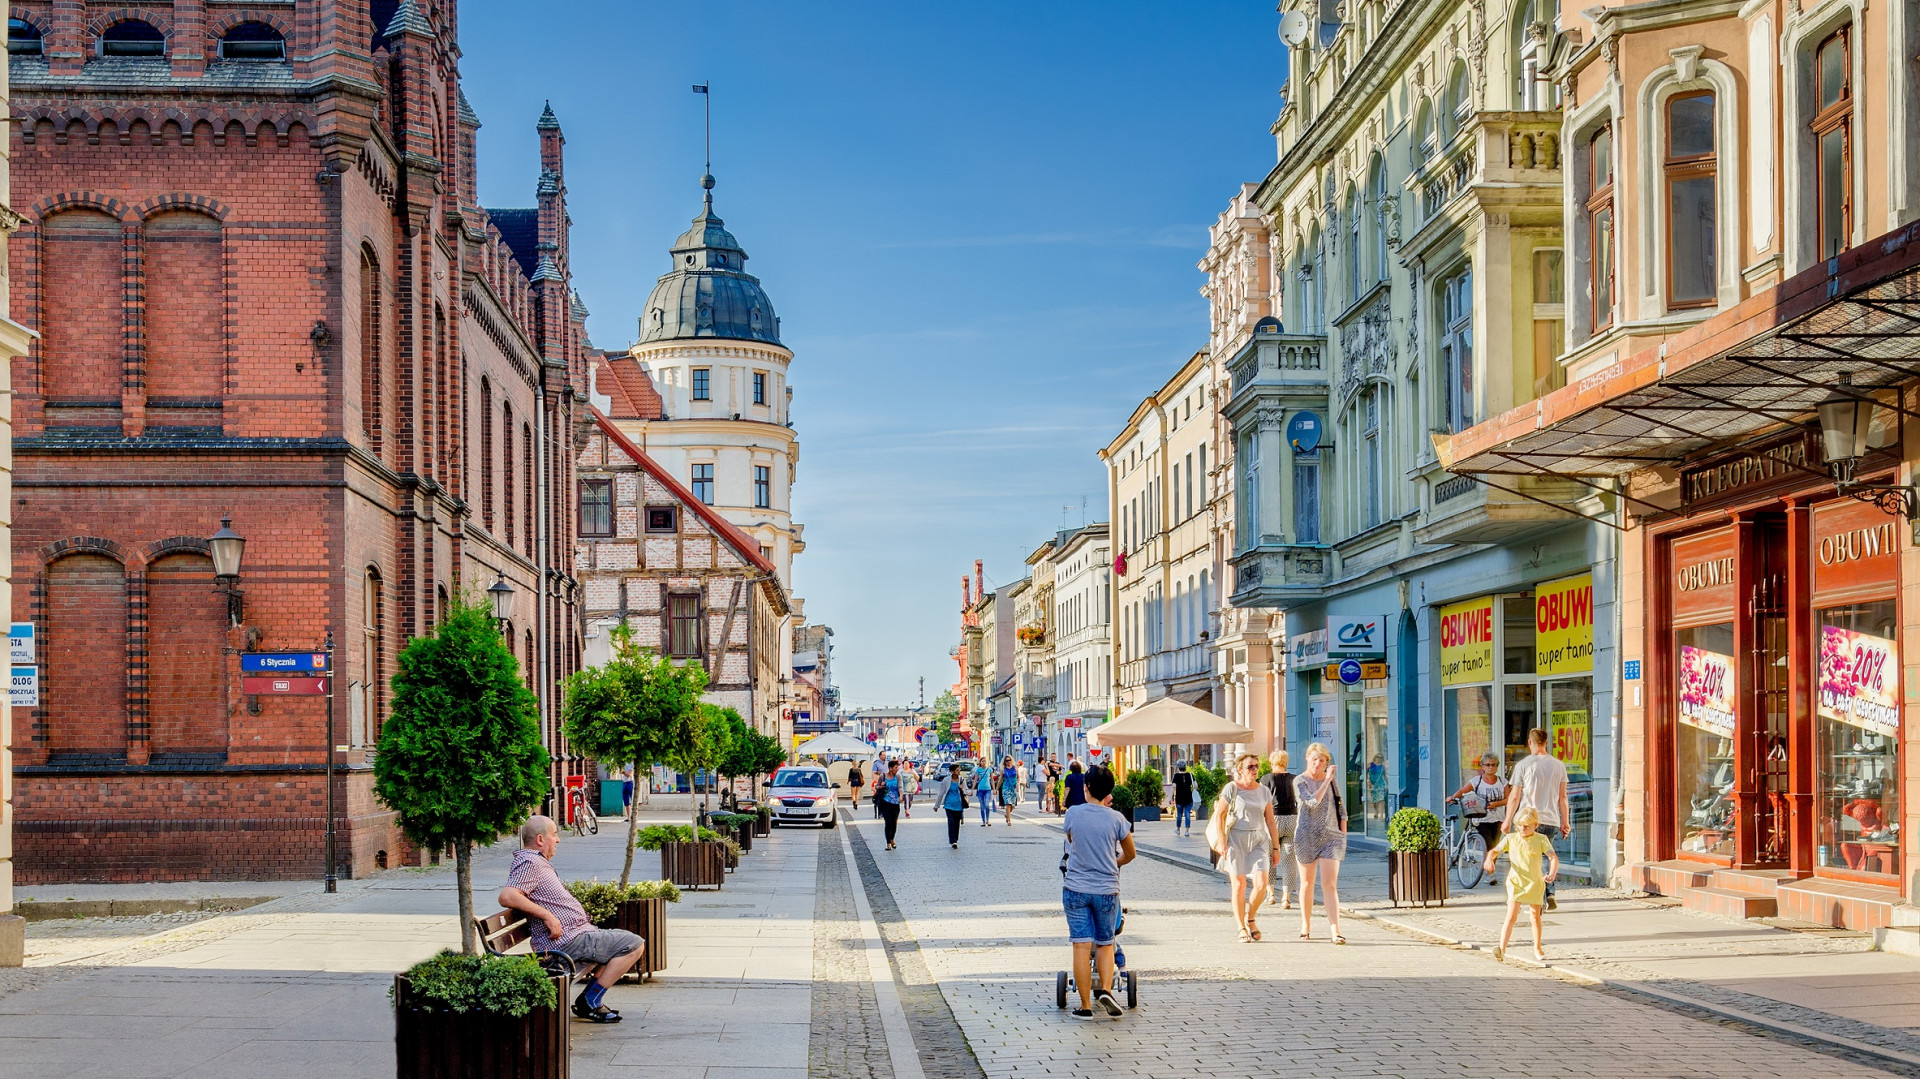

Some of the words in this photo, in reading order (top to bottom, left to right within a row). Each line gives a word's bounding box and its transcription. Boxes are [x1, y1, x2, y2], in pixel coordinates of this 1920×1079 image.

[1693, 440, 1808, 500] KLEOPATRA
[1441, 607, 1492, 648] OBUWIE
[261, 658, 266, 666] 6
[267, 658, 296, 668] Stycznia
[1539, 647, 1563, 671] super
[1566, 635, 1593, 660] tanio
[1846, 644, 1887, 691] -20%
[11, 677, 32, 686] OLOG
[1442, 663, 1459, 681] super
[1698, 661, 1726, 700] -20%
